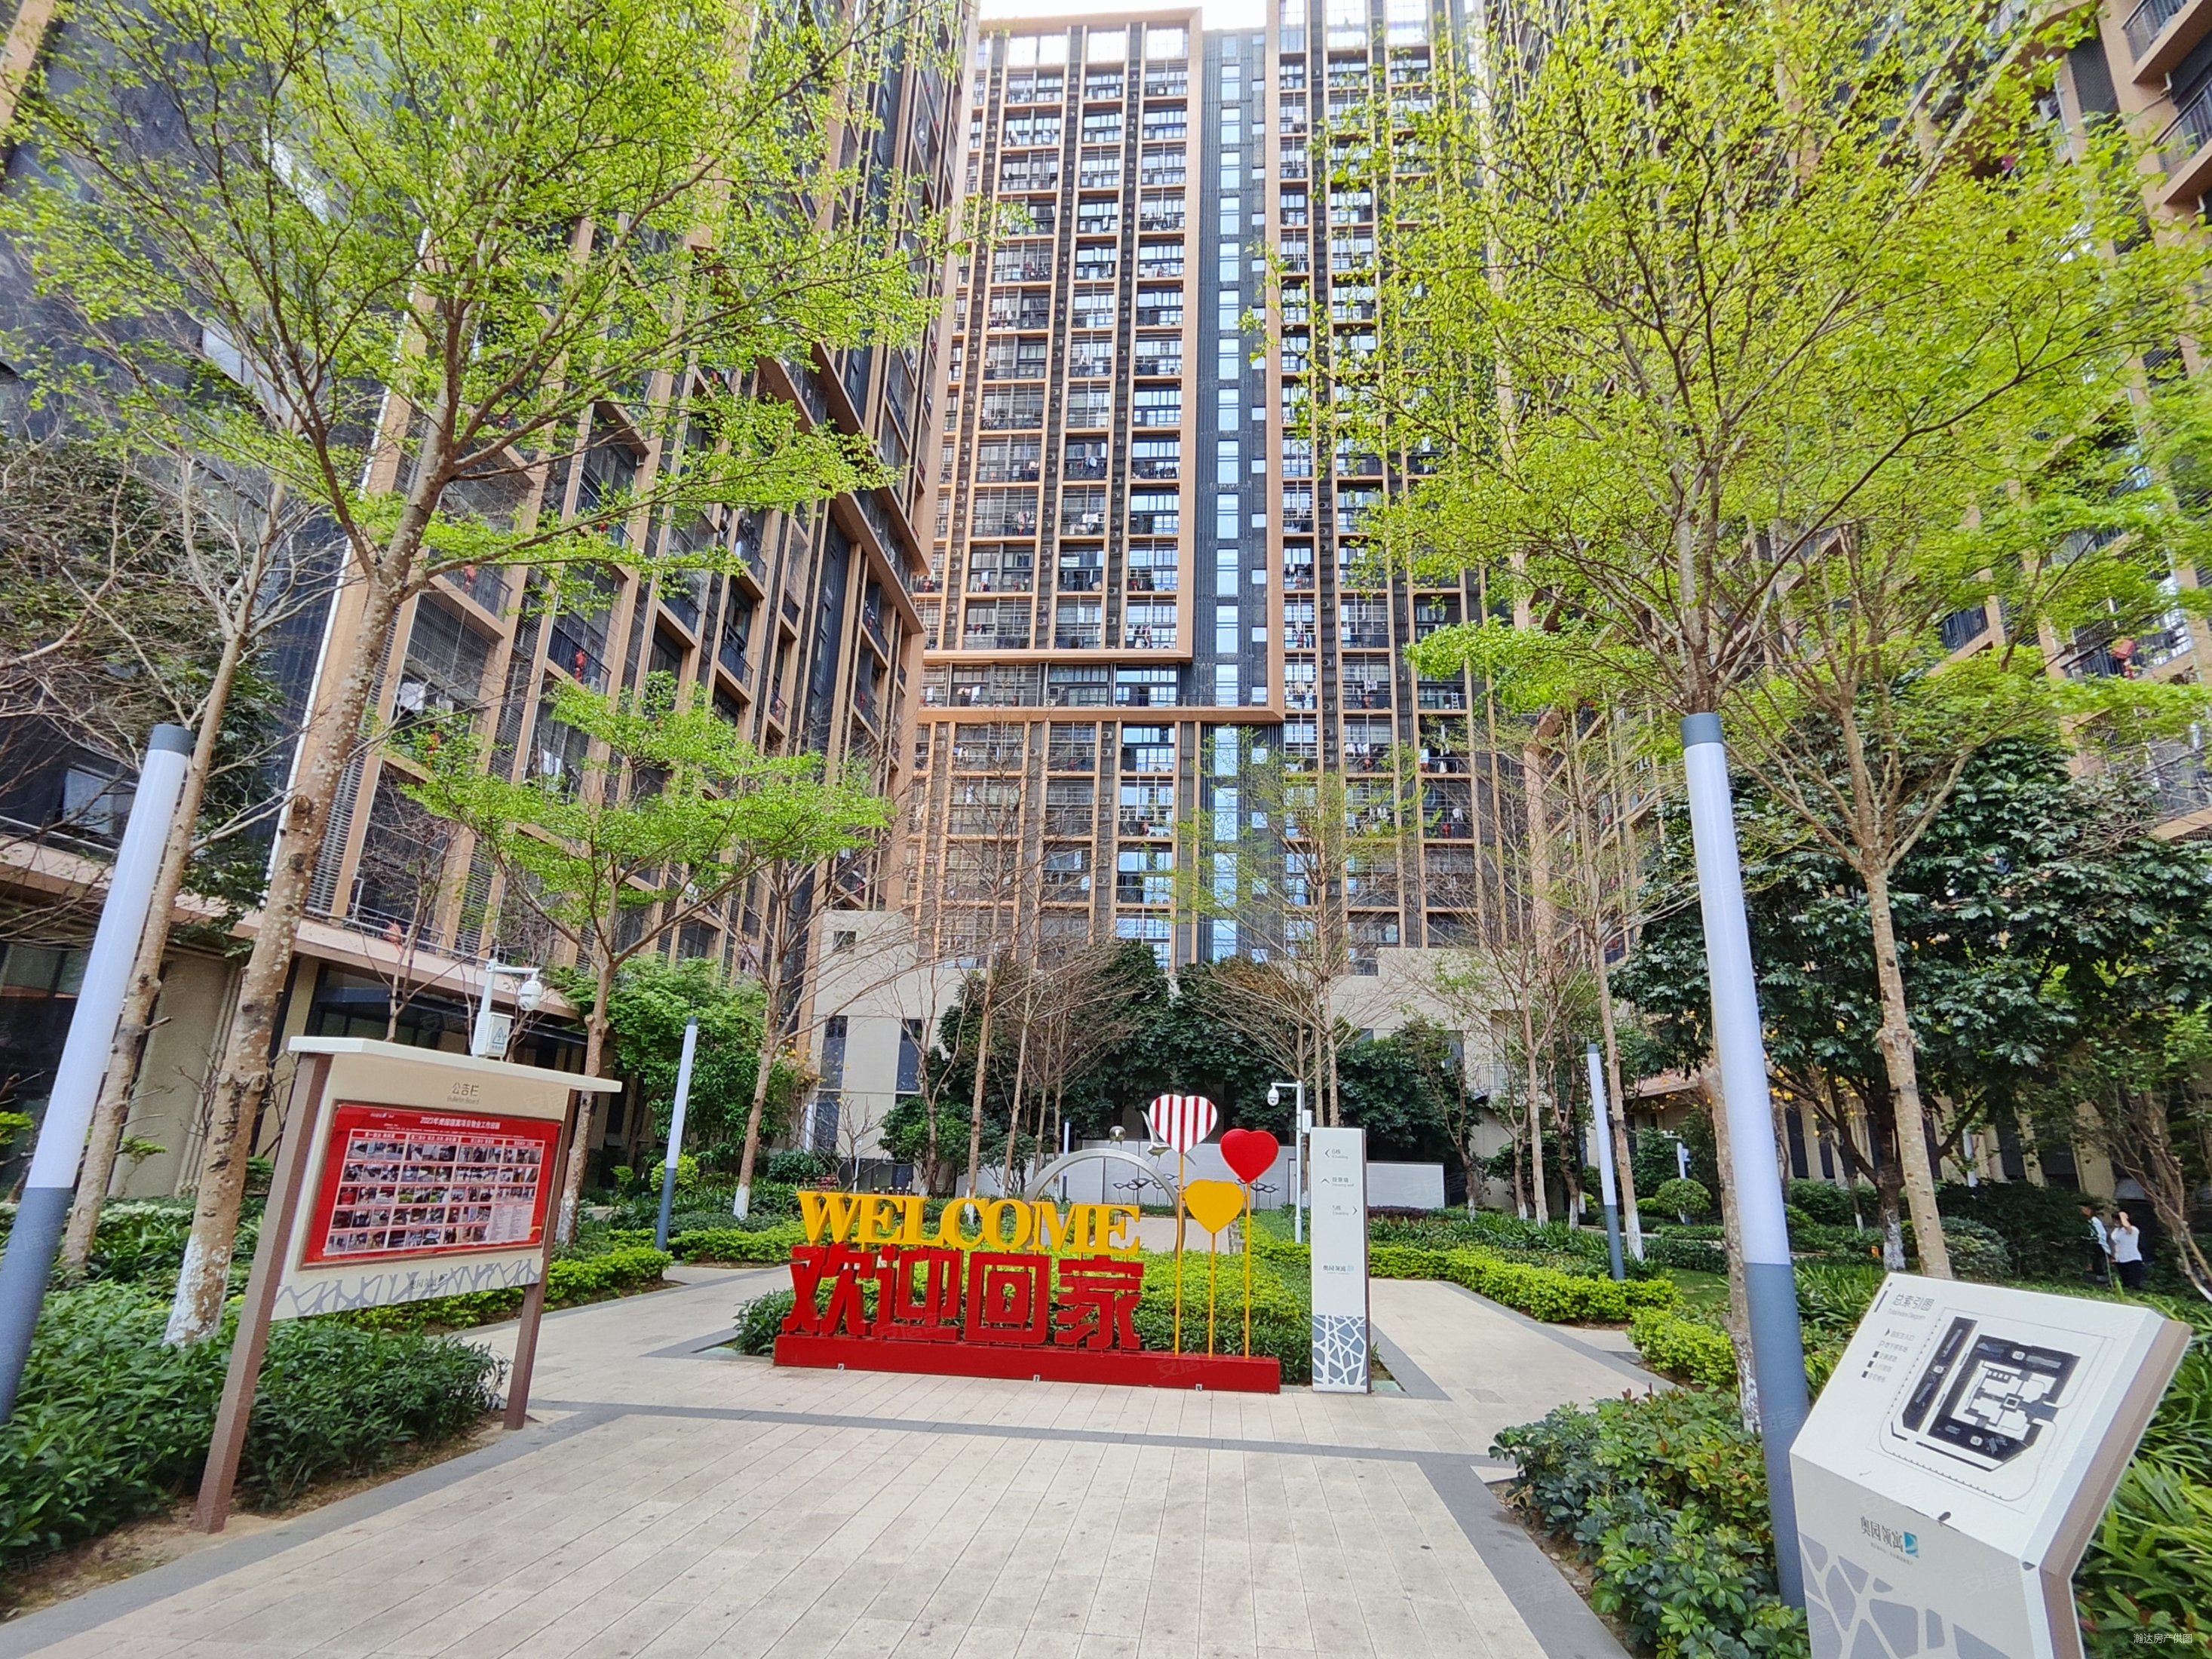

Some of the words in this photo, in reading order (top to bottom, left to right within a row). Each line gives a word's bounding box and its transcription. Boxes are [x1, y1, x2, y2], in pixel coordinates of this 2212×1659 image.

[796, 1191, 1140, 1255] WELCOME
[782, 1242, 1144, 1349] 欢迎回家
[1893, 1293, 1935, 1311] 总索引图
[1861, 1516, 1904, 1553] 奥园领寓
